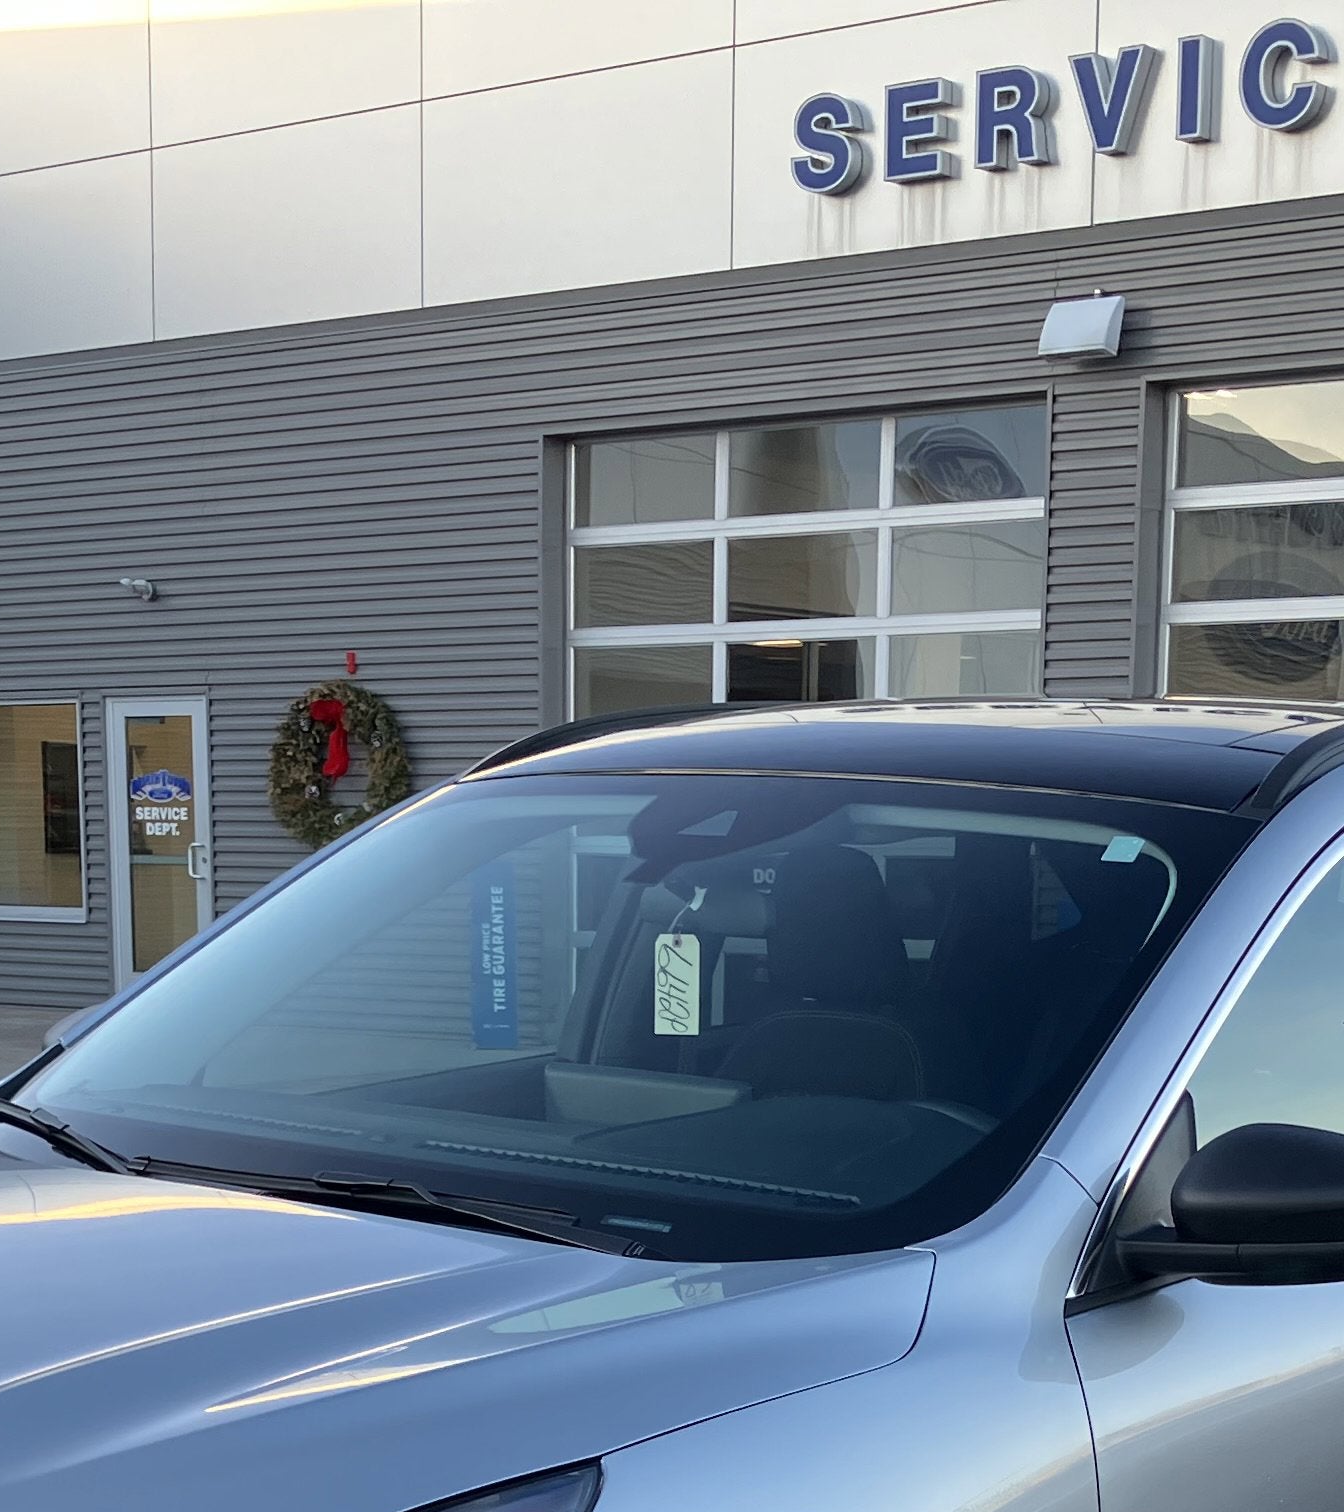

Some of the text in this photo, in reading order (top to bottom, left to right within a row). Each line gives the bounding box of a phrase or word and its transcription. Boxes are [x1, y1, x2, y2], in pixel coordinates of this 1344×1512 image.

[135, 806, 189, 820] SERVICE
[145, 822, 181, 836] DEPT.
[490, 886, 506, 975] GUARANTEE
[481, 922, 491, 975] LOW PRICE
[493, 978, 507, 1013] TIRE
